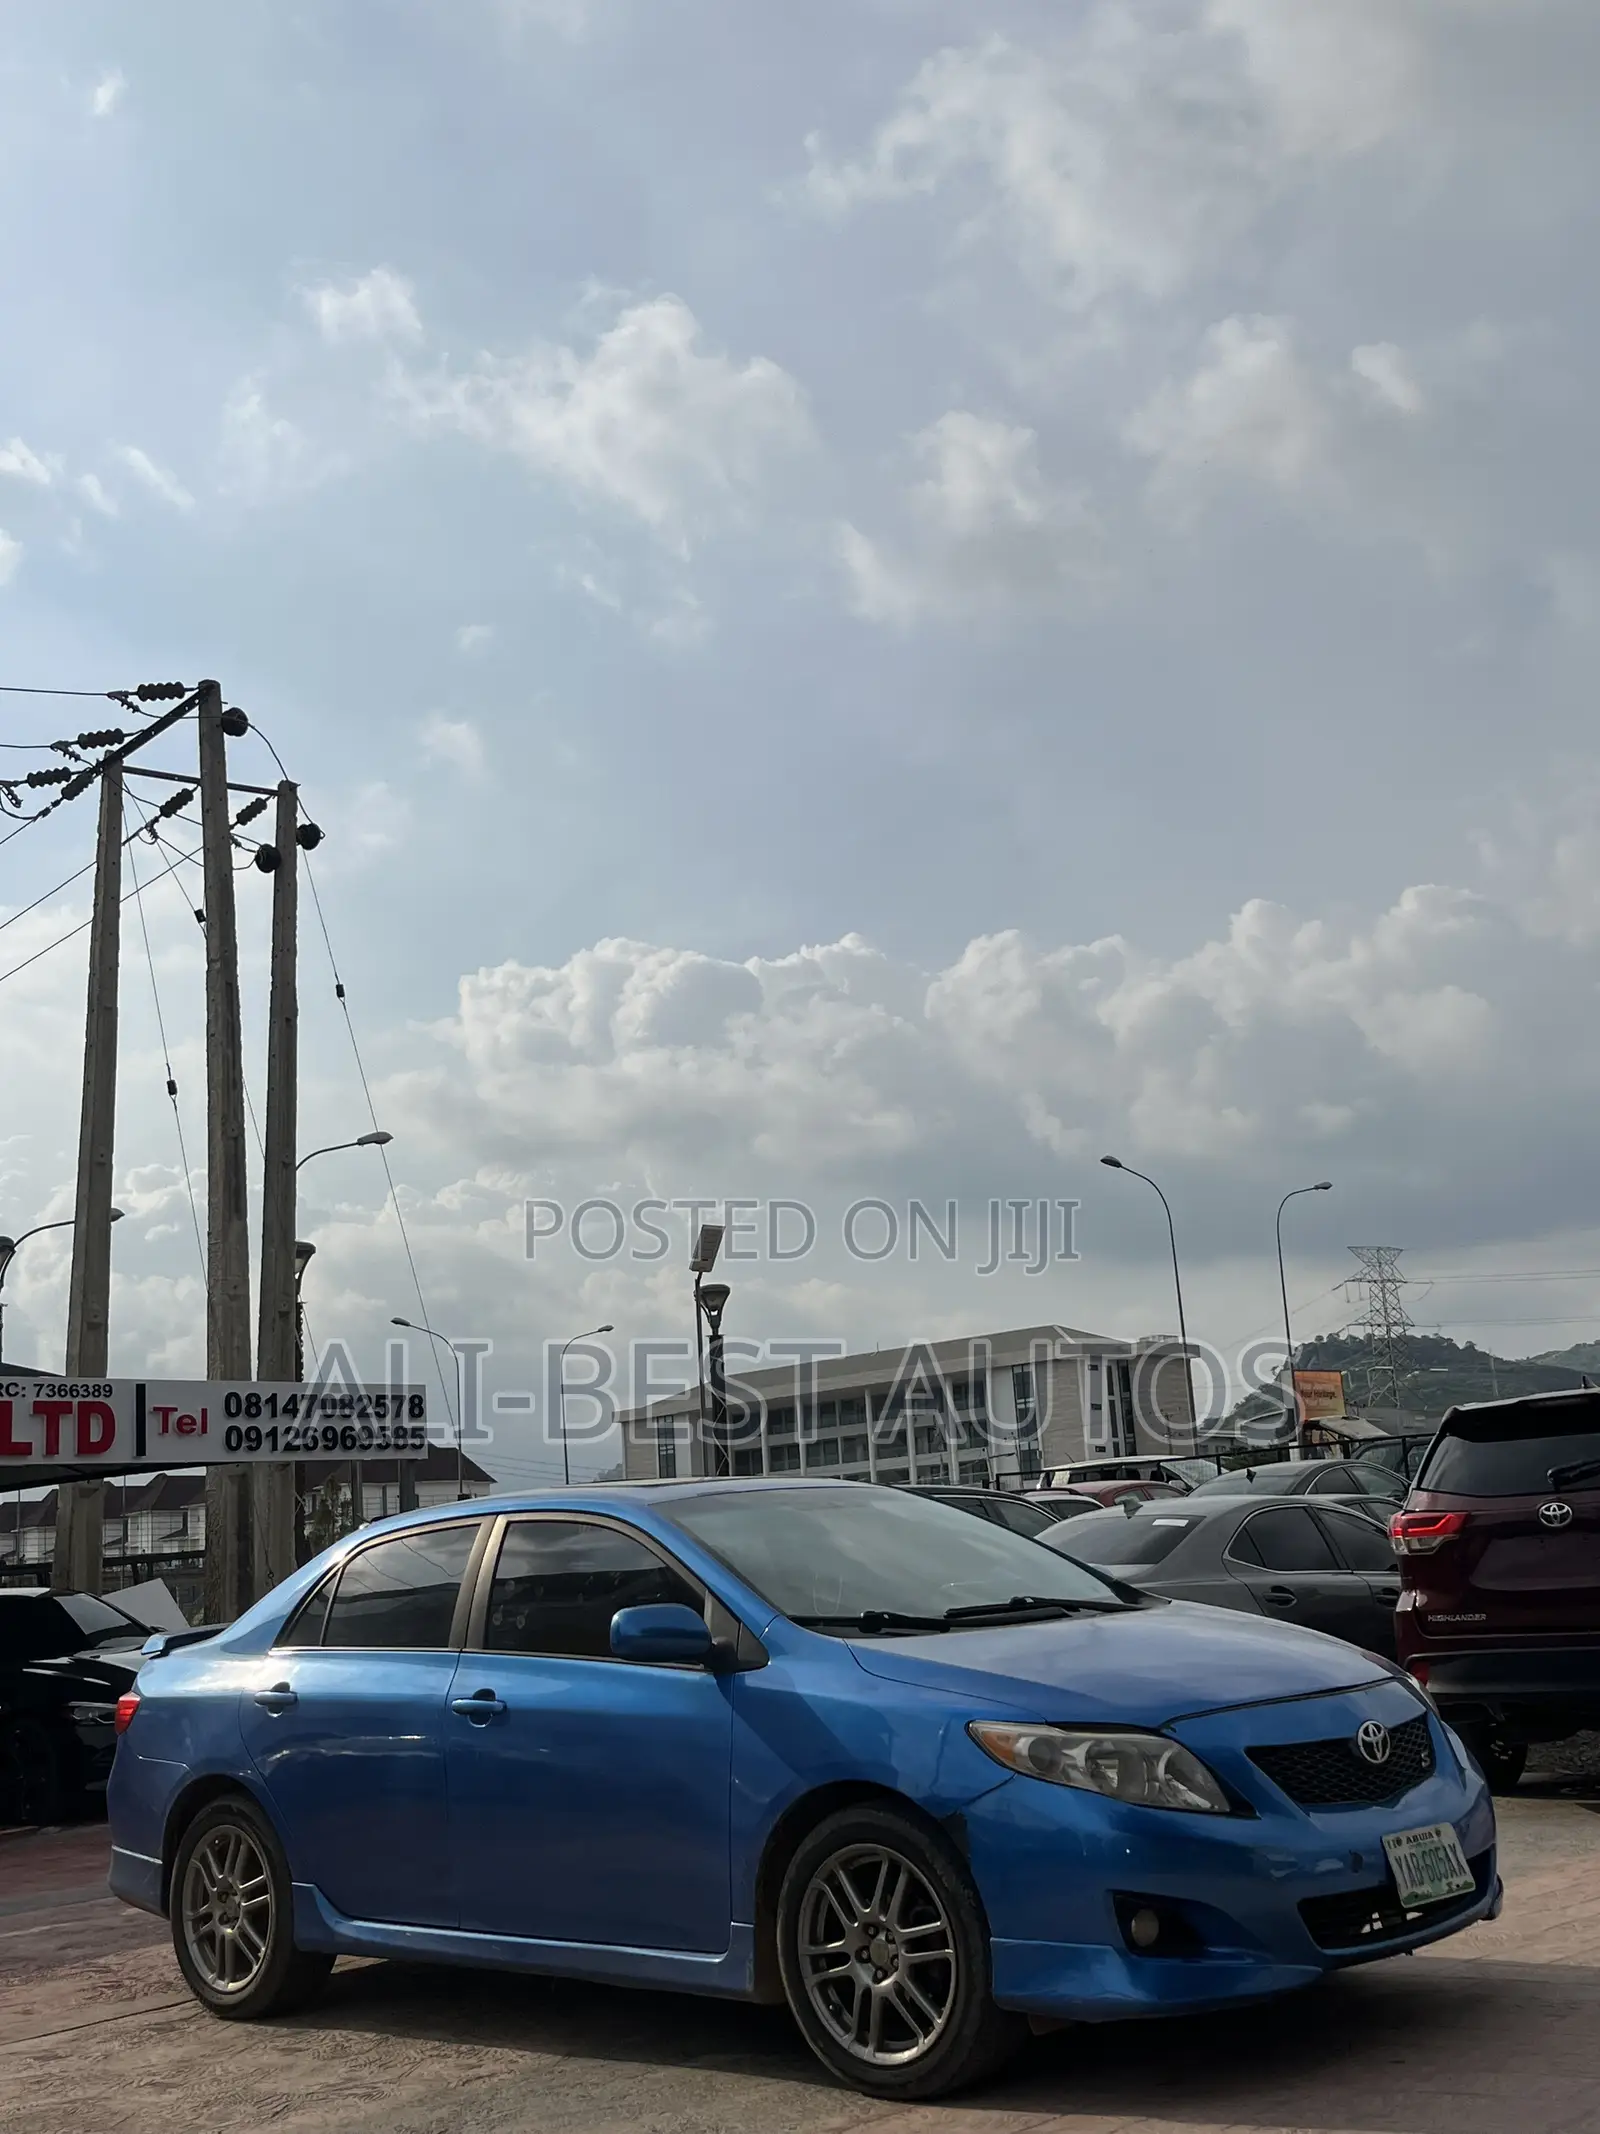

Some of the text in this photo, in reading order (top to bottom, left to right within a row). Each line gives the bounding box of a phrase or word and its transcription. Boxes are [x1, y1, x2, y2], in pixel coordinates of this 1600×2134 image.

[0, 1382, 113, 1398] C: 7366389
[224, 1391, 425, 1418] 08147082578
[0, 1400, 116, 1456] LTD
[153, 1406, 208, 1435] Tel
[225, 1425, 426, 1451] 09126969585
[1427, 1613, 1487, 1622] HIGHLANDER
